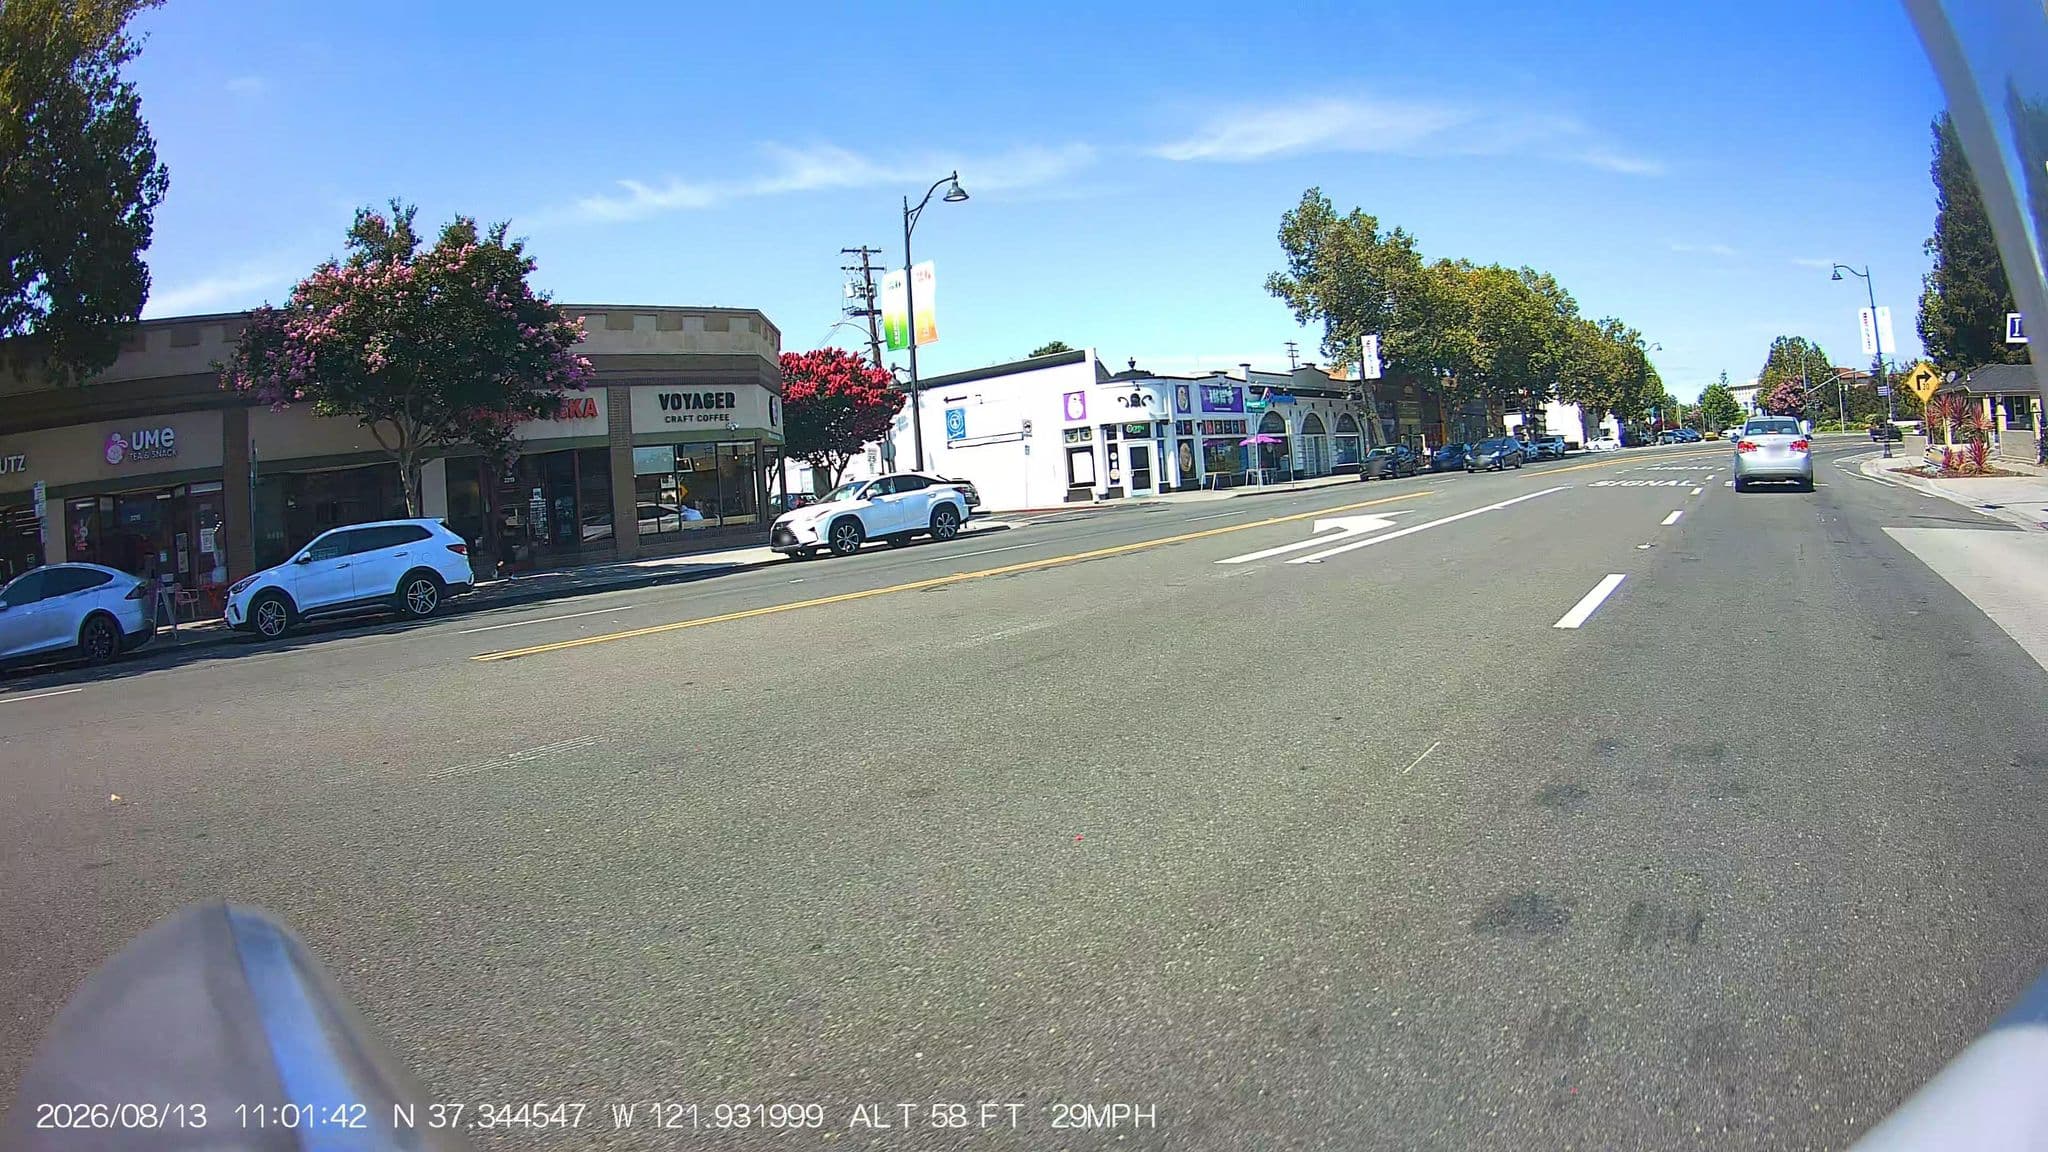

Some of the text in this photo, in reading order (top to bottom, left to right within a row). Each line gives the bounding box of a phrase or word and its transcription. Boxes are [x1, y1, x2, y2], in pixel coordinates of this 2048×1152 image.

[659, 392, 736, 411] VOYAGER
[665, 413, 730, 423] CRAFT COFFEE
[129, 451, 143, 461] TEA
[151, 449, 177, 459] SNACK
